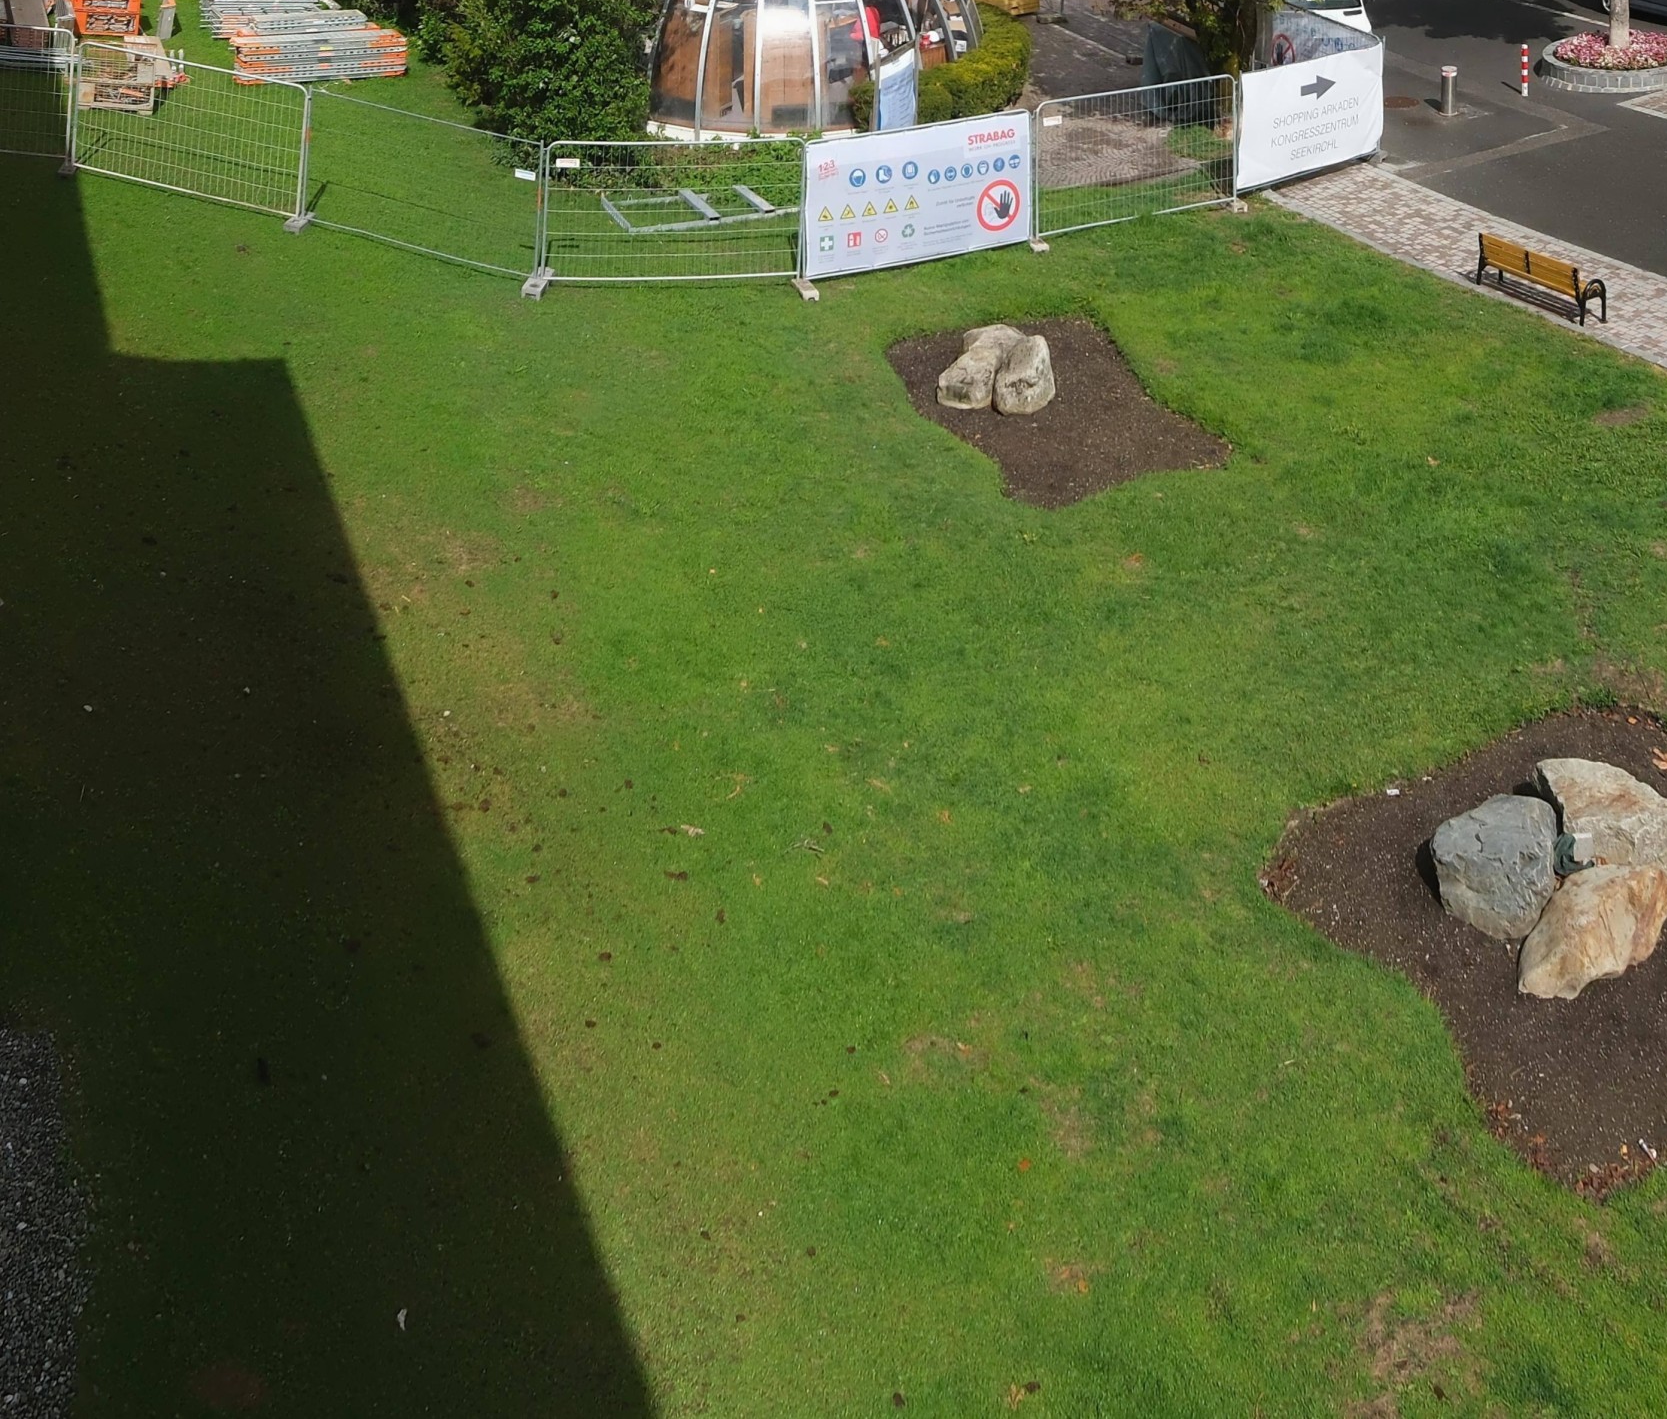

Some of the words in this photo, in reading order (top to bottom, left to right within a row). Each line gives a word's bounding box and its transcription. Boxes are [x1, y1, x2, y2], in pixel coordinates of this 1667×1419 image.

[1273, 107, 1319, 129] SHOPPING
[1321, 96, 1359, 116] ARKADEN
[967, 129, 1015, 146] STRABAG
[1271, 114, 1360, 148] KONGRESSZENTRUM
[1290, 139, 1338, 161] SEEKIRCHL
